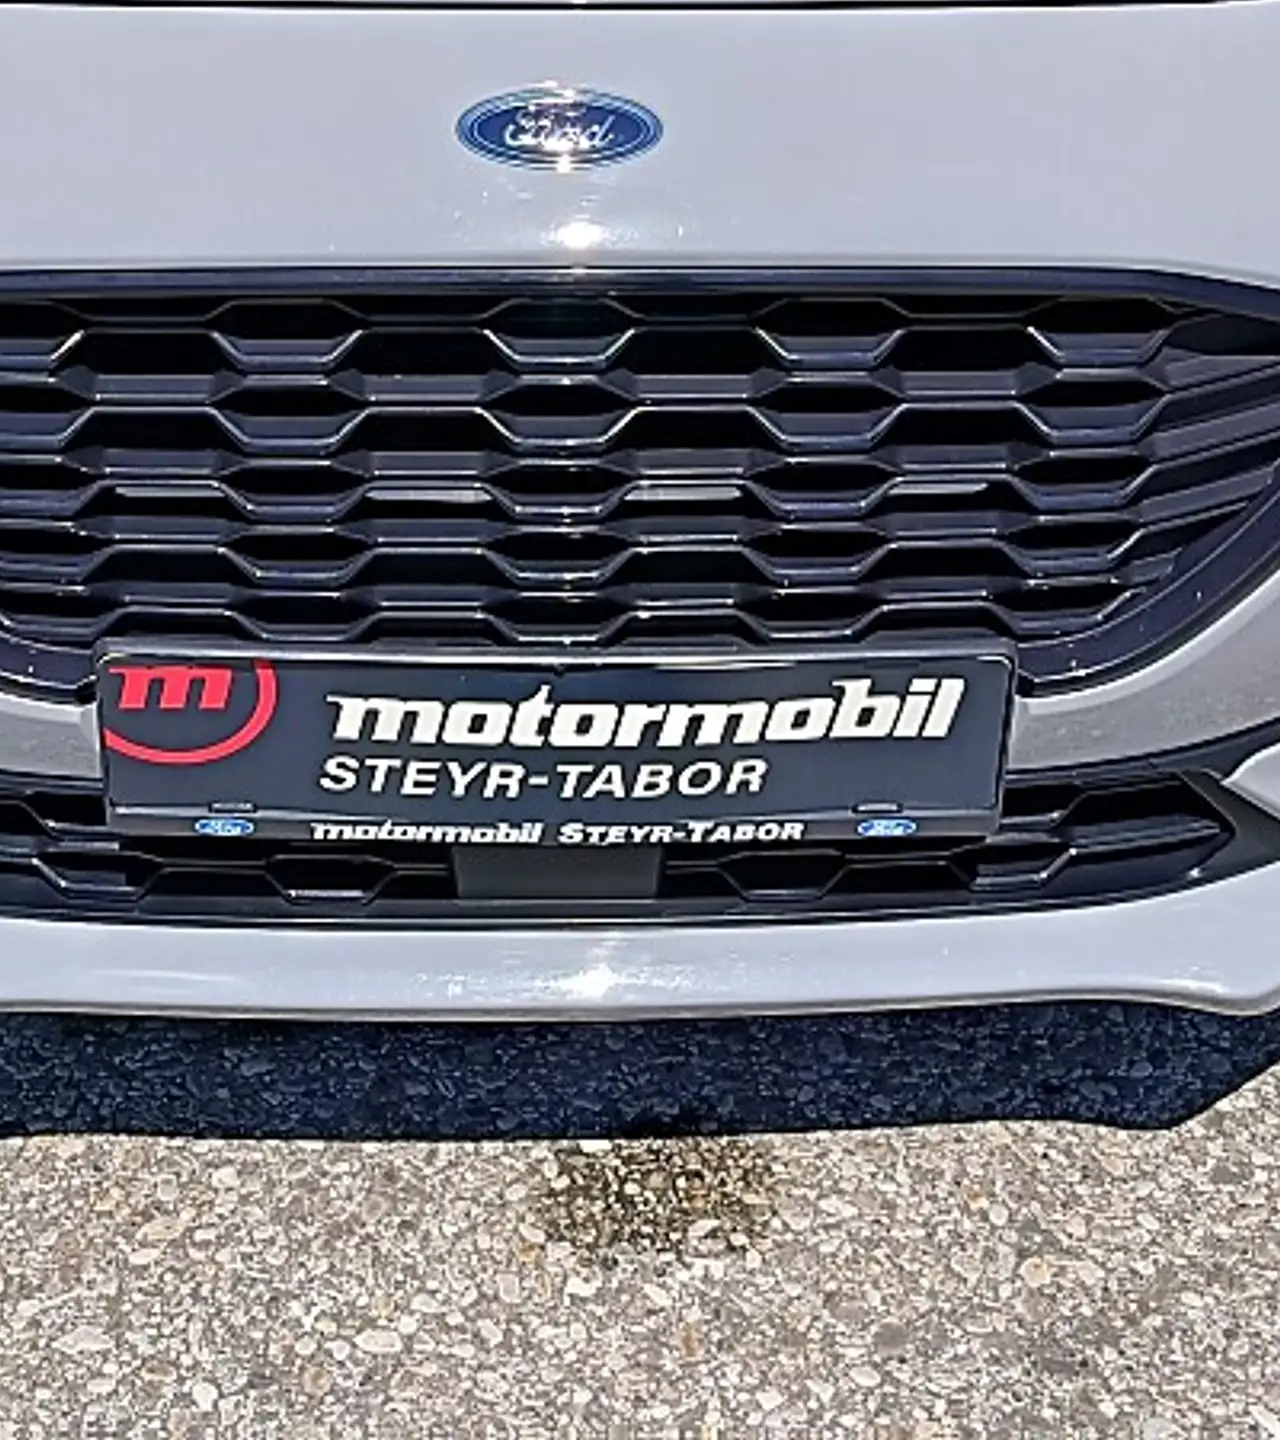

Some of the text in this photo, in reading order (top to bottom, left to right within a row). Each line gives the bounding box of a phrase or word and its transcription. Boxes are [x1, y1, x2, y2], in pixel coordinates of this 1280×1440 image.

[326, 677, 966, 748] motormobil
[319, 756, 769, 800] STEYR-TABOR
[309, 818, 544, 844] motormobil
